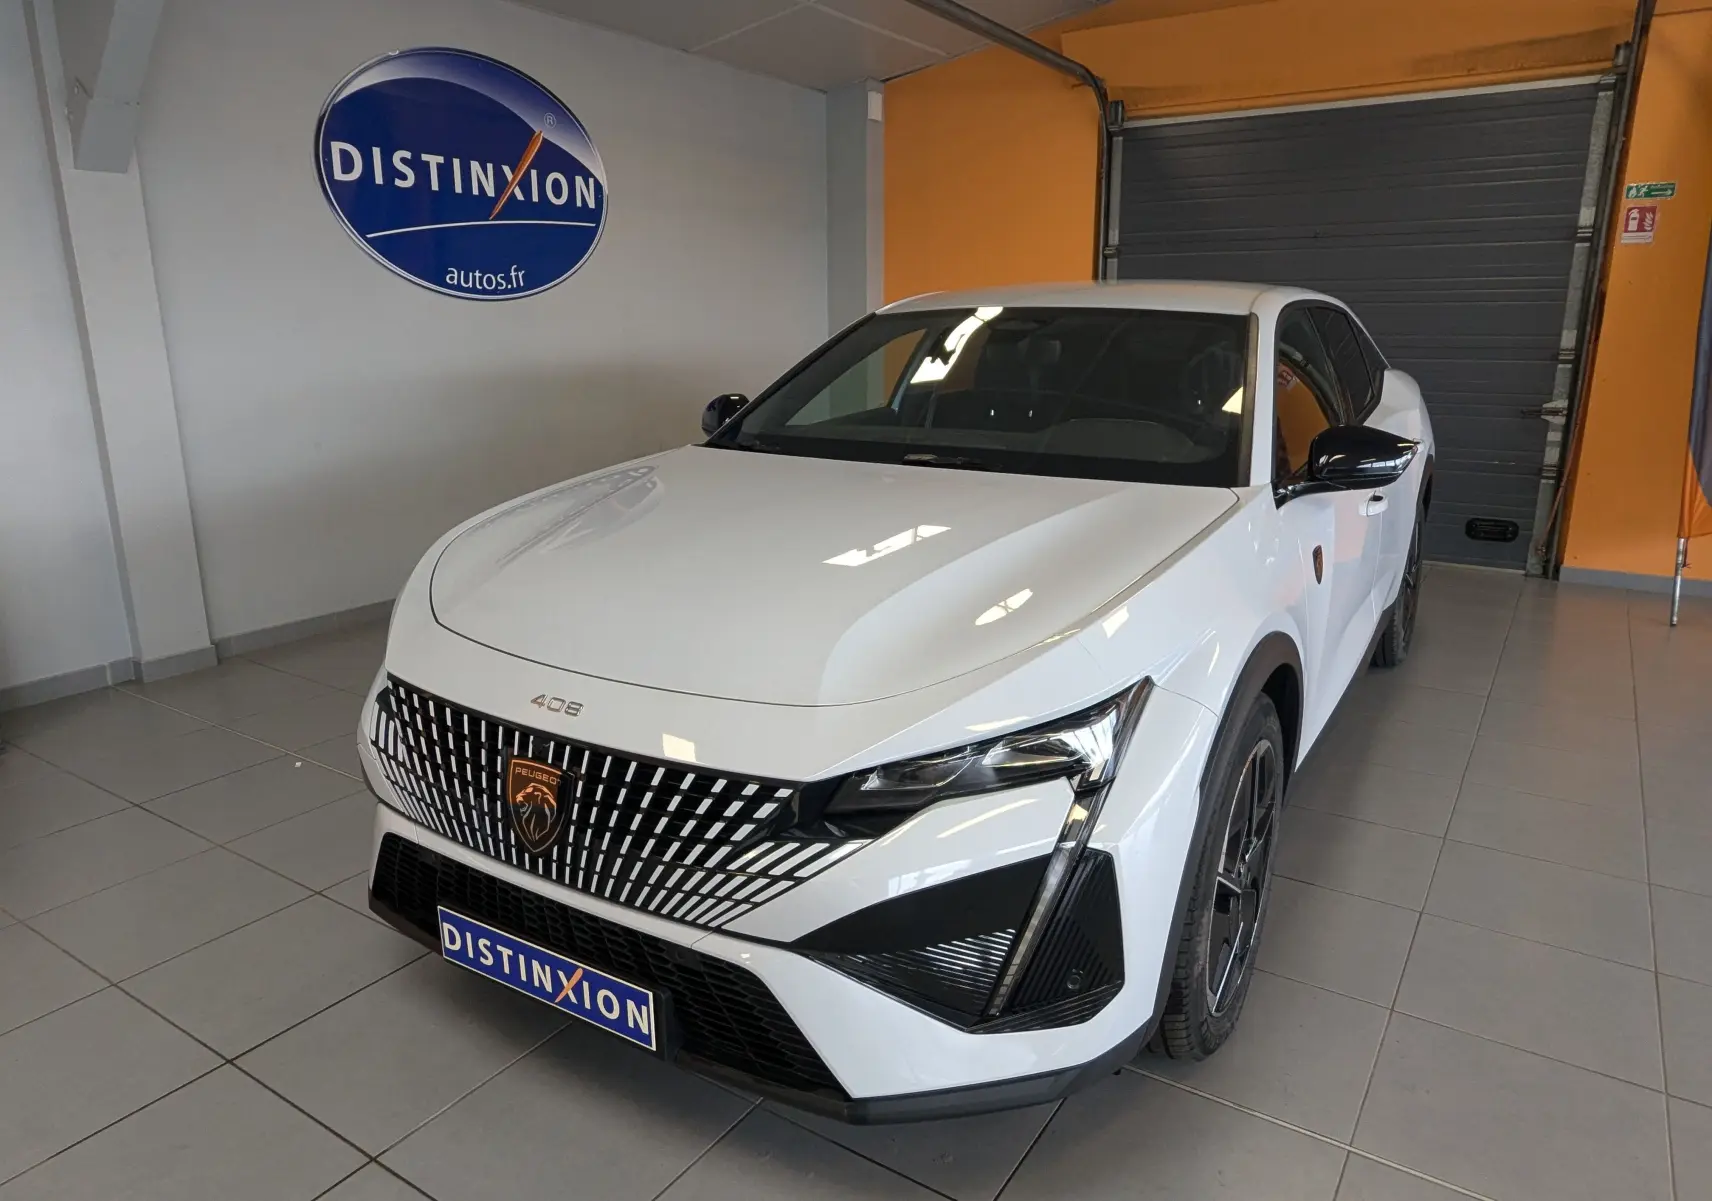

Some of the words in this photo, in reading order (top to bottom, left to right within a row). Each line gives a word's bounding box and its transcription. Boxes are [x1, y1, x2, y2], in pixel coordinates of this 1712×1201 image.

[330, 130, 596, 220] DISTINXION
[446, 265, 526, 290] autos.fr
[530, 694, 584, 717] 408
[515, 767, 561, 786] PEUGEOT
[442, 922, 650, 1036] DISTINXION
